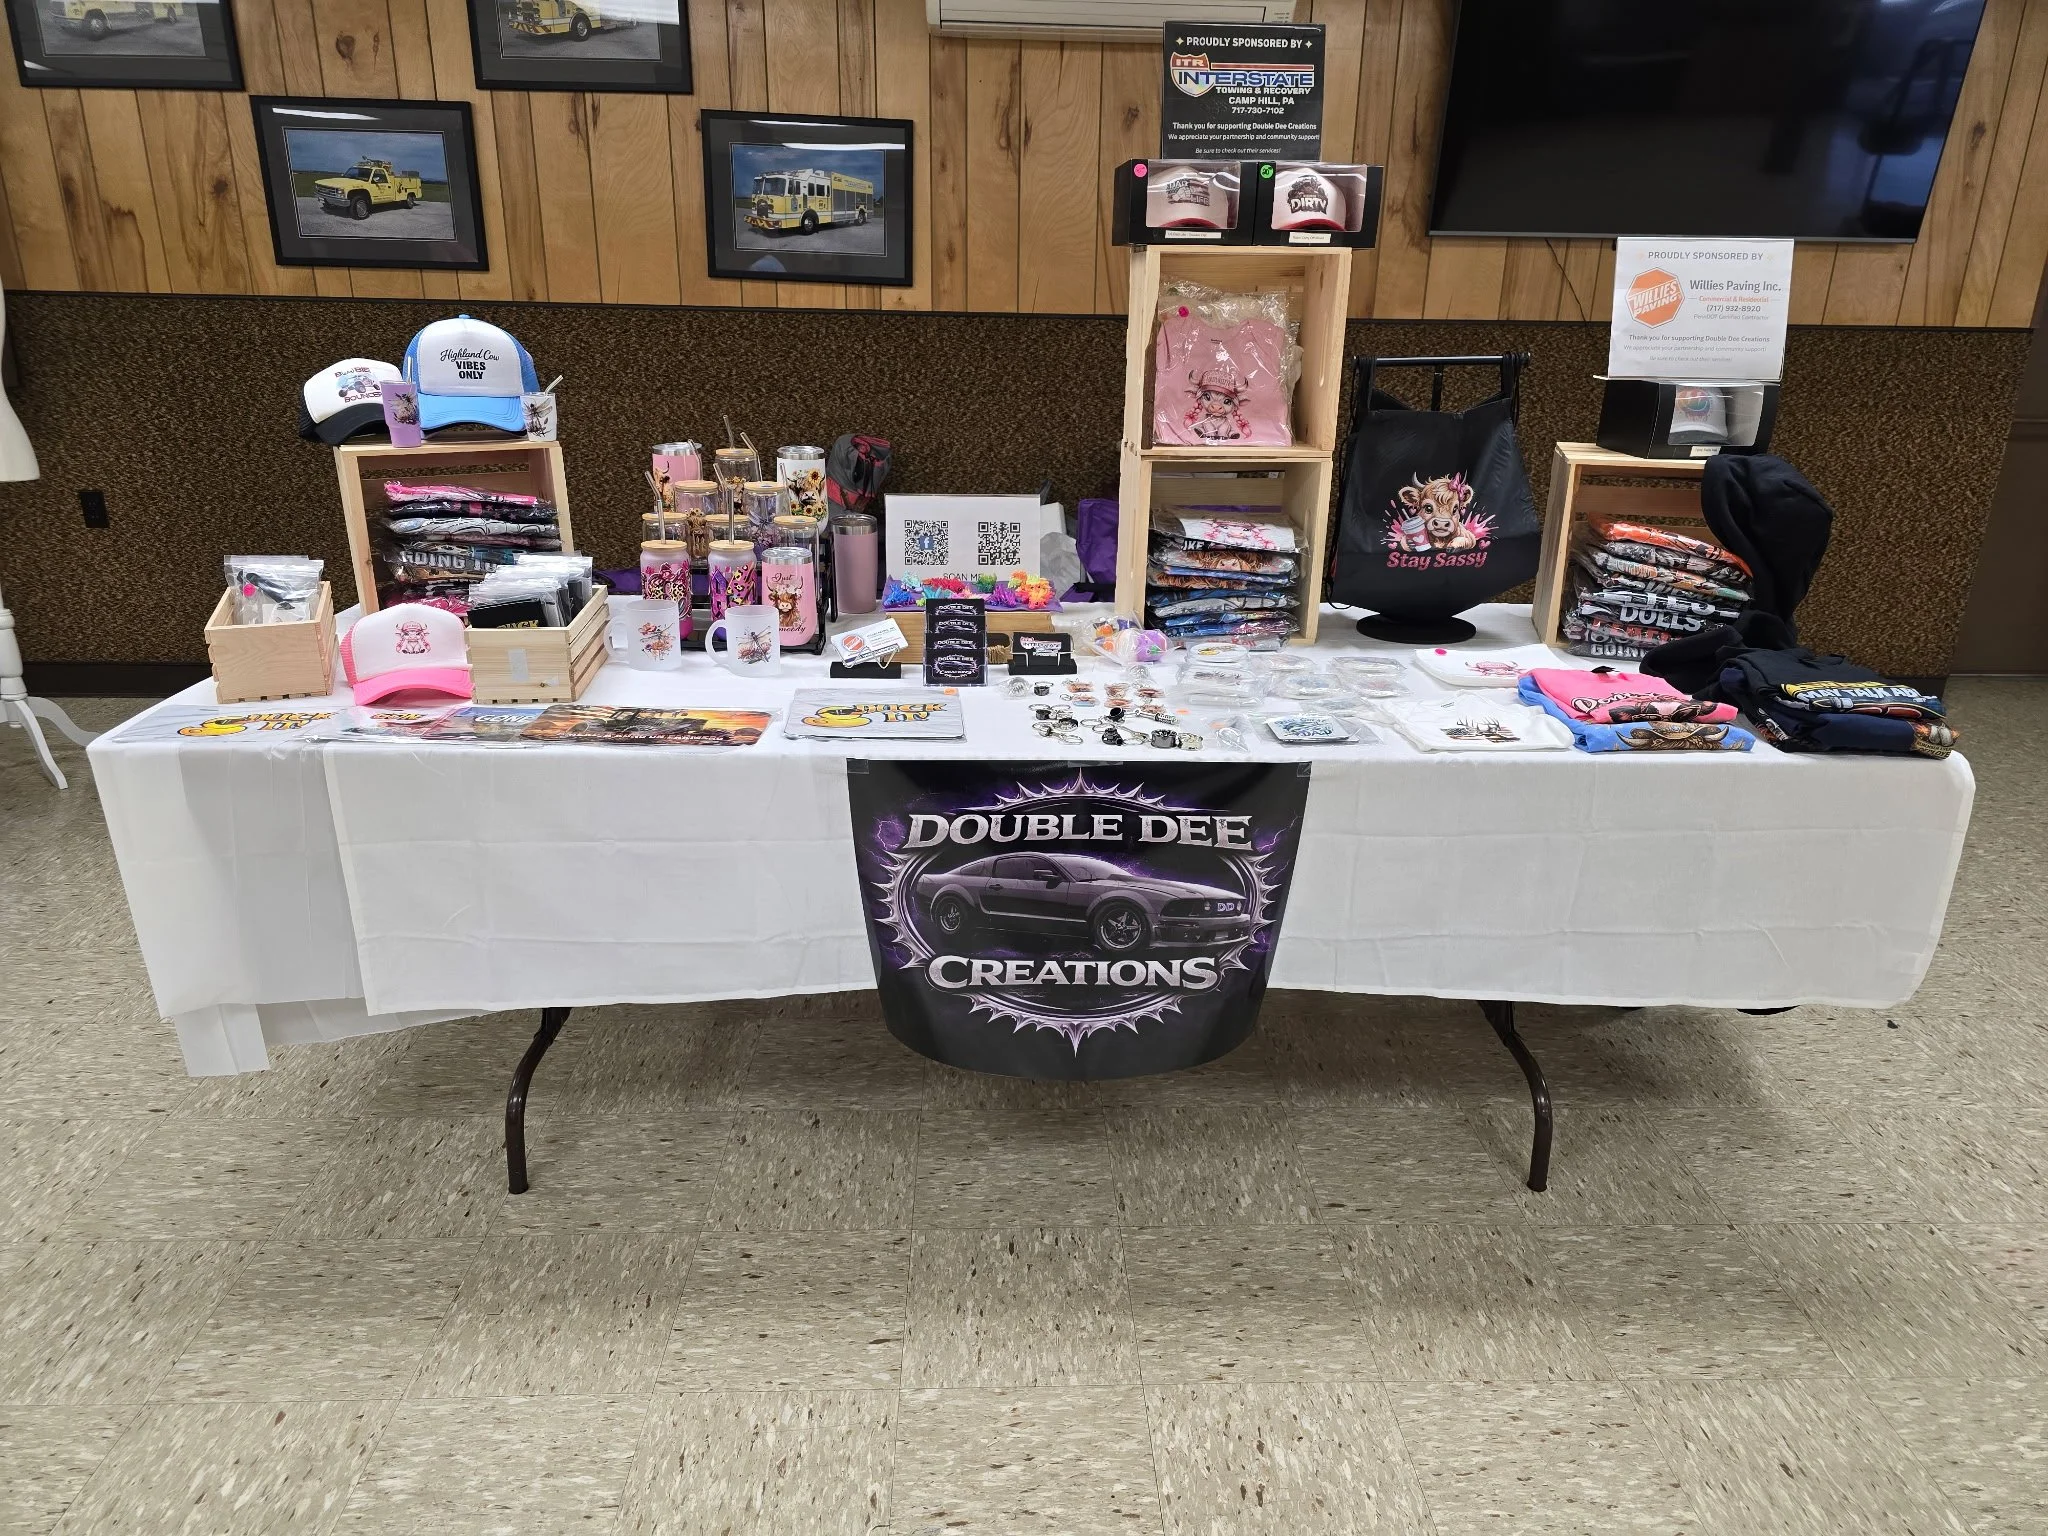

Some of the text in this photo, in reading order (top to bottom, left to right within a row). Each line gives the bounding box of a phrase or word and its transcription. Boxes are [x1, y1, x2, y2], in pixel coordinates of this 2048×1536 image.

[1186, 36, 1302, 48] PROUDLY SPONSORED BY
[1175, 58, 1204, 67] ITR
[1178, 71, 1314, 86] INTERSTATE
[1216, 86, 1253, 94] TOWING
[1264, 87, 1311, 95] RECOVERY
[1228, 96, 1295, 106] CAMP HILL, PA
[1172, 122, 1192, 130] Thank
[1206, 122, 1216, 130] for
[1217, 122, 1251, 131] supporting
[1252, 122, 1274, 130] Double
[1291, 198, 1326, 211] DIRTY
[1648, 252, 1763, 260] PROUDLY SPONSORED BY
[1690, 280, 1782, 294] Willies Paving Inc.
[1632, 280, 1678, 310] WILLIES
[1632, 293, 1679, 318] PAVING
[440, 348, 500, 362] Highland Cow
[456, 361, 486, 370] VIBES
[459, 371, 484, 379] ONLY
[1386, 552, 1488, 571] Stay Sassy
[772, 572, 796, 582] Just
[1796, 688, 1842, 701] MAY
[1846, 687, 1892, 698] TALK
[853, 703, 948, 712] DUCK
[903, 814, 1254, 850] DOUBLE DEE
[1216, 902, 1234, 912] DD
[925, 954, 1218, 990] CREATIONS
